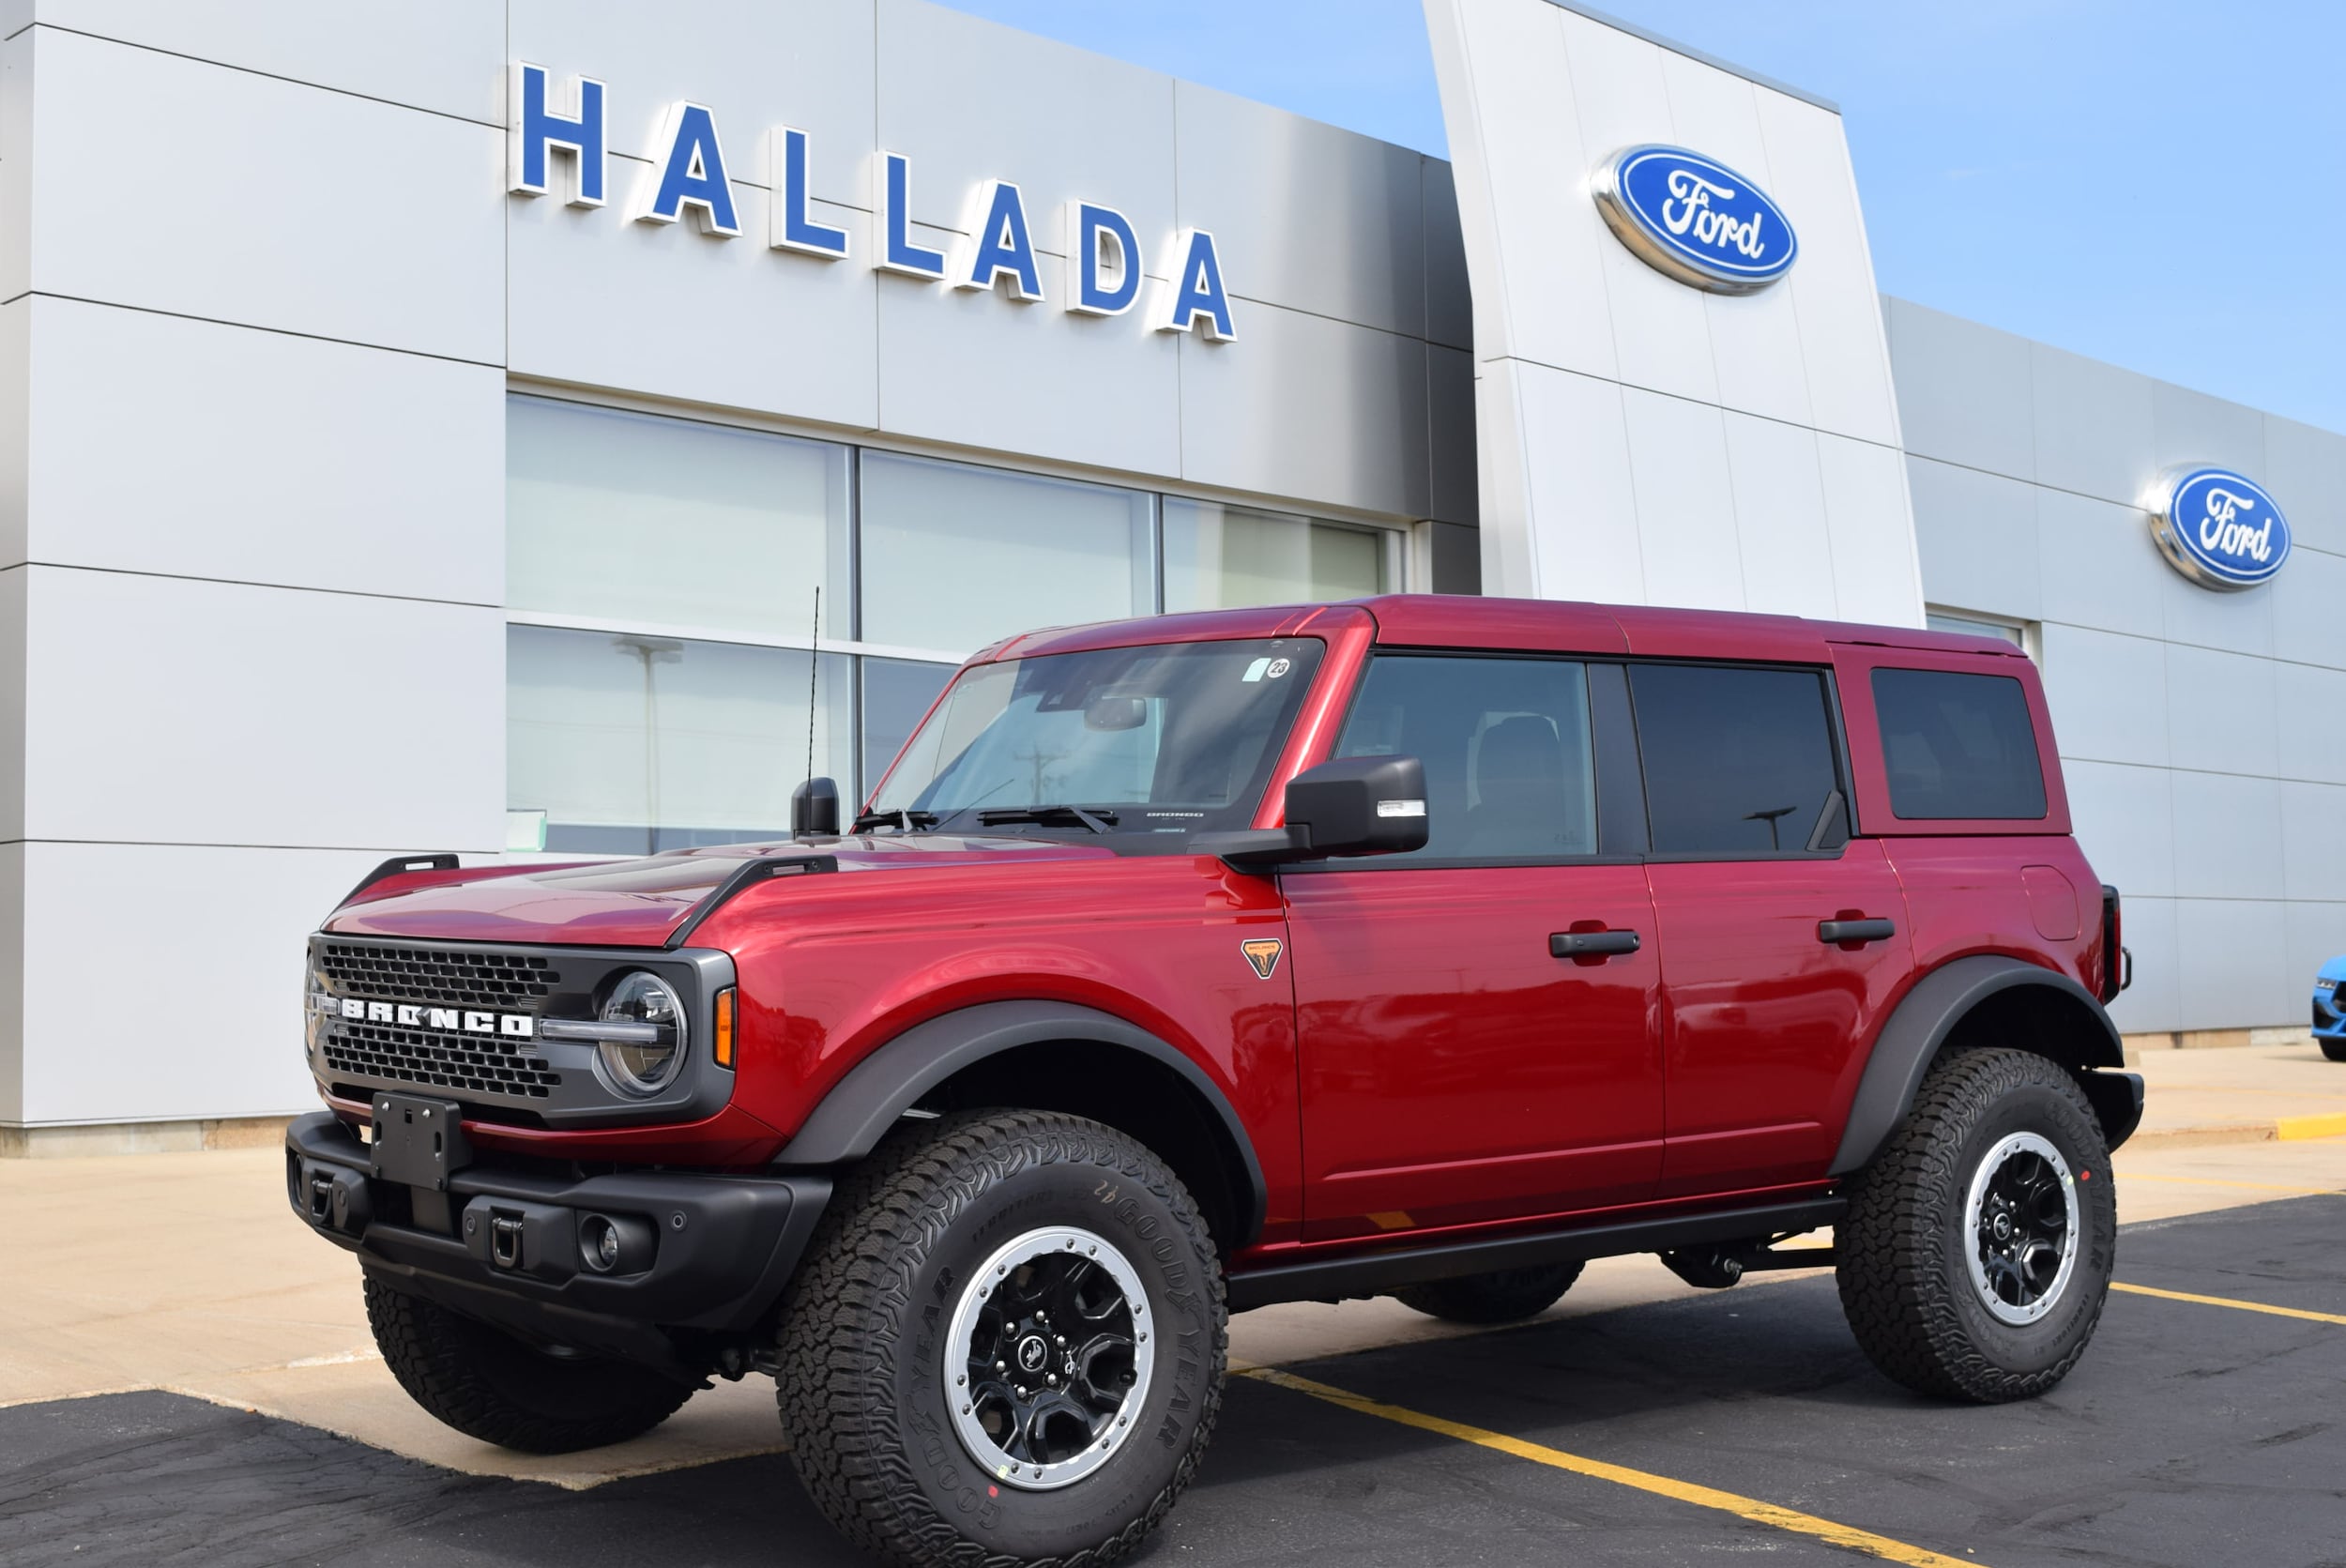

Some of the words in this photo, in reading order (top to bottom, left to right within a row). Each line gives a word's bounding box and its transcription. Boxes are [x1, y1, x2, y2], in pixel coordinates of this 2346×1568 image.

[510, 60, 1238, 343] HALLADA
[1662, 170, 1764, 259] Ford
[2200, 488, 2273, 562] Ford
[1270, 662, 1287, 674] 23
[342, 998, 533, 1037] BRONCO
[1116, 1196, 1204, 1450] GOODYEAR
[906, 1265, 1001, 1530] GOODYEAR
